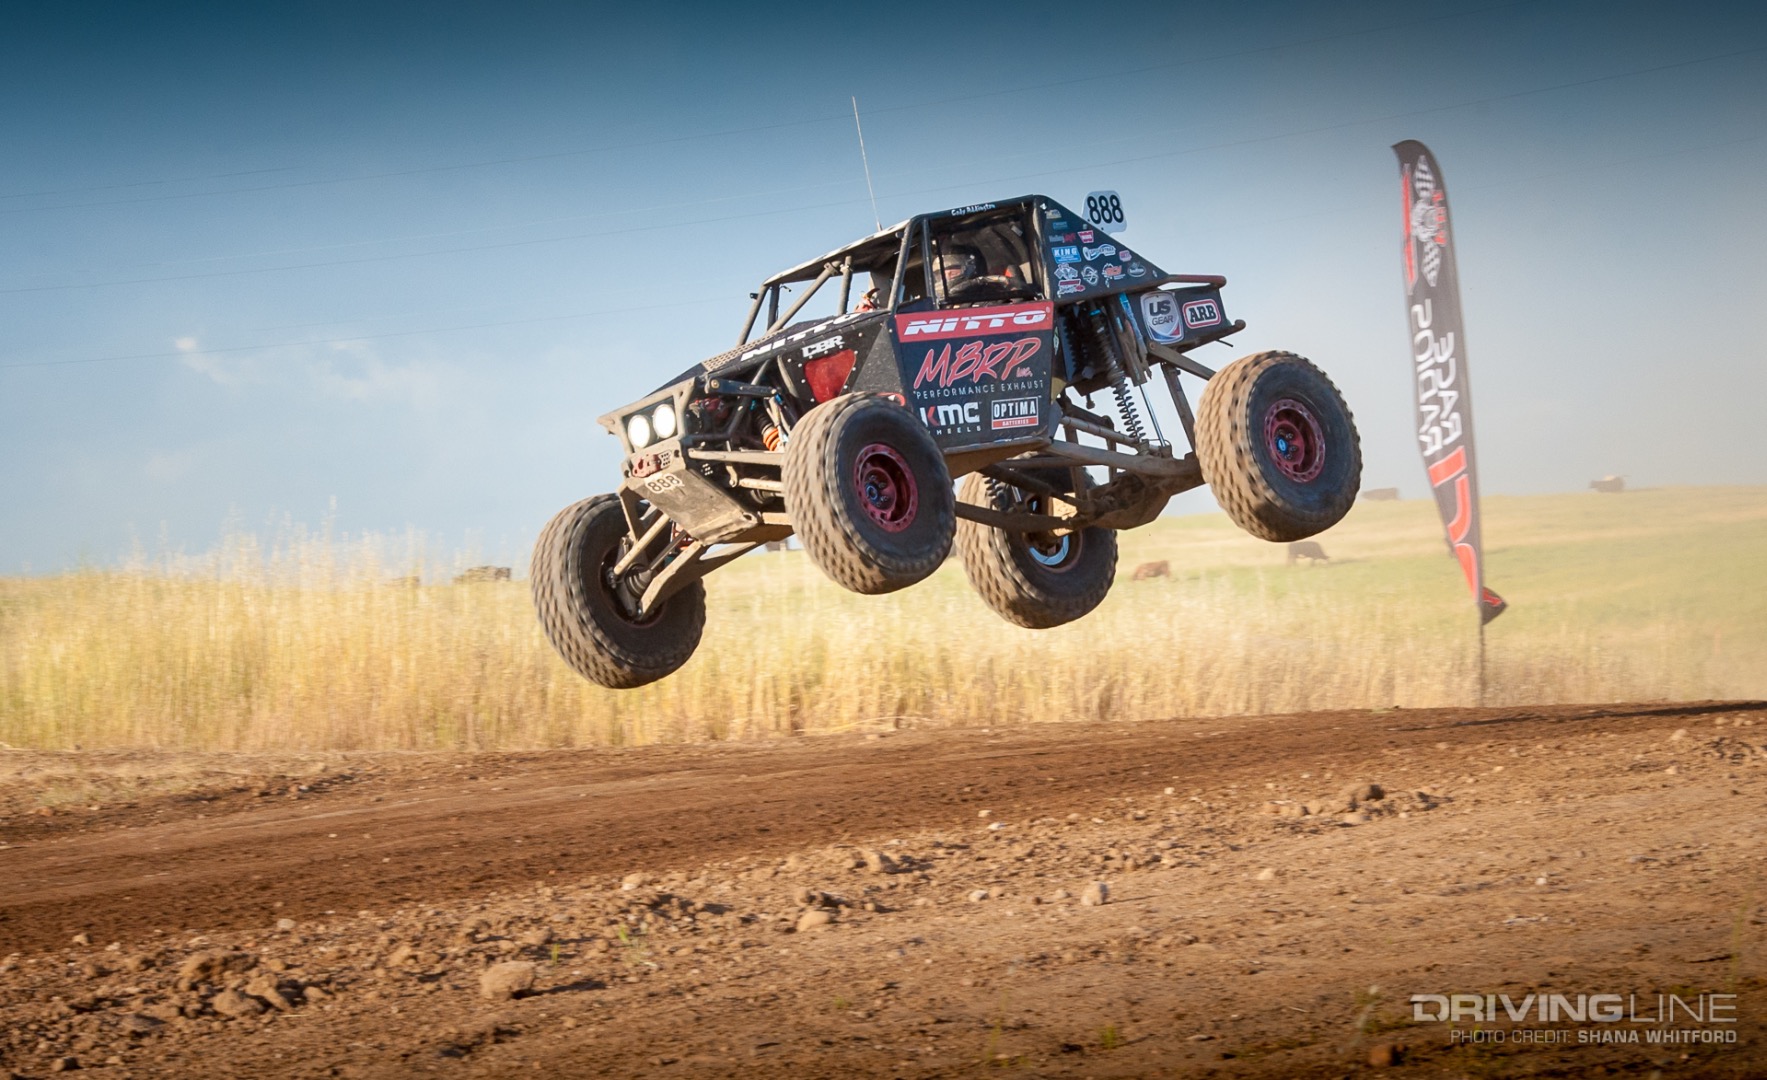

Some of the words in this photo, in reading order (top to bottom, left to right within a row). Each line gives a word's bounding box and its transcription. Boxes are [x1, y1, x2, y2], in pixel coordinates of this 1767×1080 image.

[1087, 194, 1124, 224] 888
[1053, 247, 1078, 257] KING
[1149, 299, 1171, 317] US
[1189, 304, 1217, 323] ARB
[904, 309, 1047, 336] NITTO
[1152, 315, 1174, 326] GEAR
[913, 337, 1042, 390] MBRP
[1001, 379, 1043, 391] EXHAUST
[993, 400, 1036, 418] OPTIMA
[928, 425, 982, 436] HEELS
[1002, 418, 1029, 427] BATTERIES
[646, 473, 681, 493] 888
